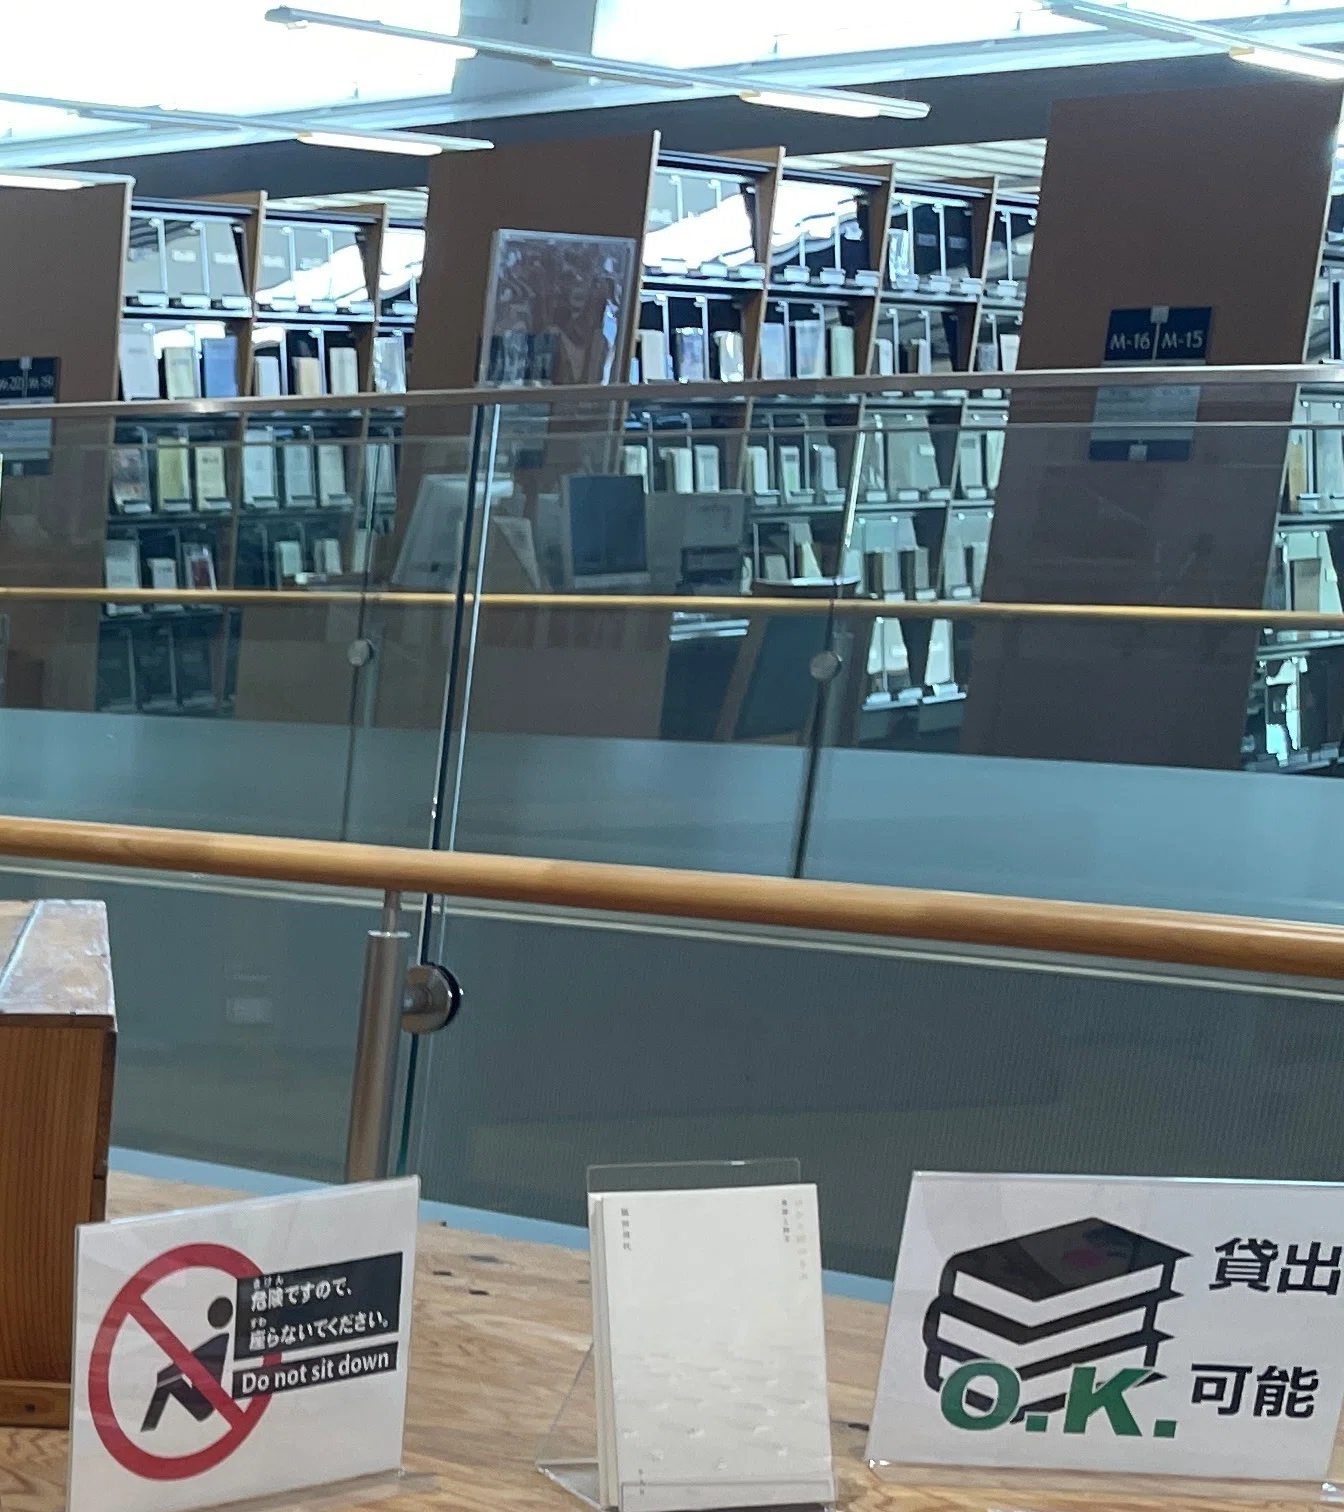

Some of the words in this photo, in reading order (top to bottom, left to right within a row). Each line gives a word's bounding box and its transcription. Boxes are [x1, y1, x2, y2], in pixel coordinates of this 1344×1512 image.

[1110, 332, 1151, 350] M-16
[1161, 329, 1204, 349] M-15
[1209, 1237, 1343, 1297] 貸出
[251, 1276, 352, 1312] 危険ですので、
[250, 1310, 389, 1351] 座らないでください。
[242, 1372, 270, 1395] Do
[275, 1364, 308, 1388] not
[312, 1357, 334, 1382] sit
[338, 1353, 389, 1375] down
[1190, 1364, 1319, 1419] 可能
[940, 1361, 1178, 1439] O.K.
